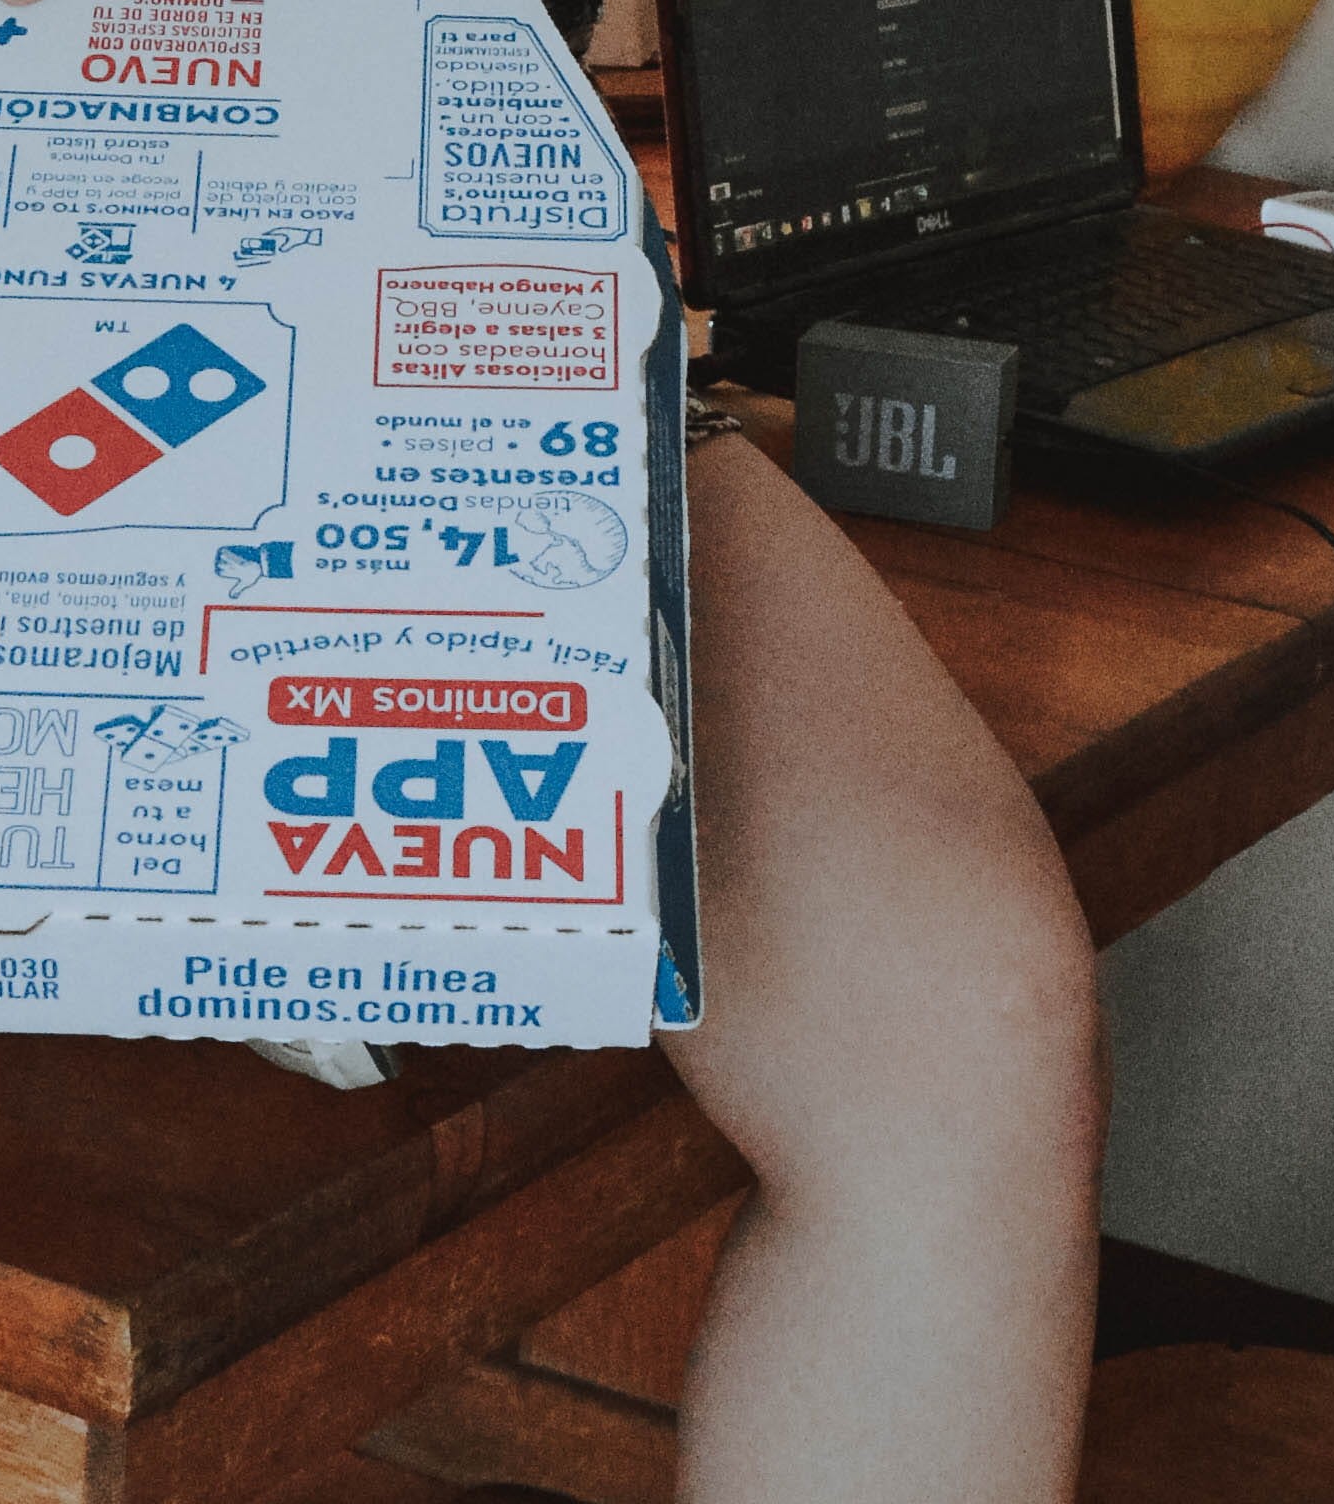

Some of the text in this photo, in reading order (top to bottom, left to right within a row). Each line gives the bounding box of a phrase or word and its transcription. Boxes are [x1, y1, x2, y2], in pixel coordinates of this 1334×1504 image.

[88, 35, 261, 54] ESPOLVOREADO CON
[441, 32, 516, 43] para ti
[81, 52, 262, 88] NUEVO
[437, 97, 562, 111] ambiente
[461, 114, 552, 125] con un
[439, 125, 580, 139] comedores,
[444, 143, 580, 168] NUEVOS
[444, 172, 603, 186] en nuestros
[444, 189, 606, 203] tu Domino's
[14, 201, 189, 217] DOMINO'S TO GO
[203, 208, 354, 222] PAGO EN LÍNEA
[443, 206, 607, 229] Disfruta
[79, 271, 204, 291] NUEVAS
[219, 275, 236, 291] 4
[386, 280, 604, 296] y Mango Habanero
[387, 297, 604, 320] Cayenne, BBQ
[394, 321, 605, 340] 3 salsas a elegir:
[398, 343, 605, 363] horneadas con
[391, 362, 606, 381] Deliciosas Alitas
[375, 415, 531, 430] en el mundo
[404, 420, 618, 457] 89 países
[835, 392, 956, 479] JBL
[375, 467, 620, 487] presentes en
[317, 492, 571, 514] tiendas Domino's
[316, 559, 410, 574] más de
[57, 571, 168, 588] seguiremos
[177, 571, 185, 587] y
[18, 616, 141, 637] nuestros
[152, 620, 185, 640] de
[231, 627, 628, 675] Fácil, rápido y divertido
[287, 685, 571, 721] Dominos Mx
[125, 778, 202, 794] mesa
[264, 738, 588, 822] APP
[132, 806, 190, 823] a tu
[0, 825, 75, 870] TU
[117, 831, 206, 852] horno
[267, 822, 584, 882] NUEVA
[133, 857, 181, 877] Del
[185, 956, 497, 993] Pide en línea
[139, 988, 542, 1028] dominos.com.mx
